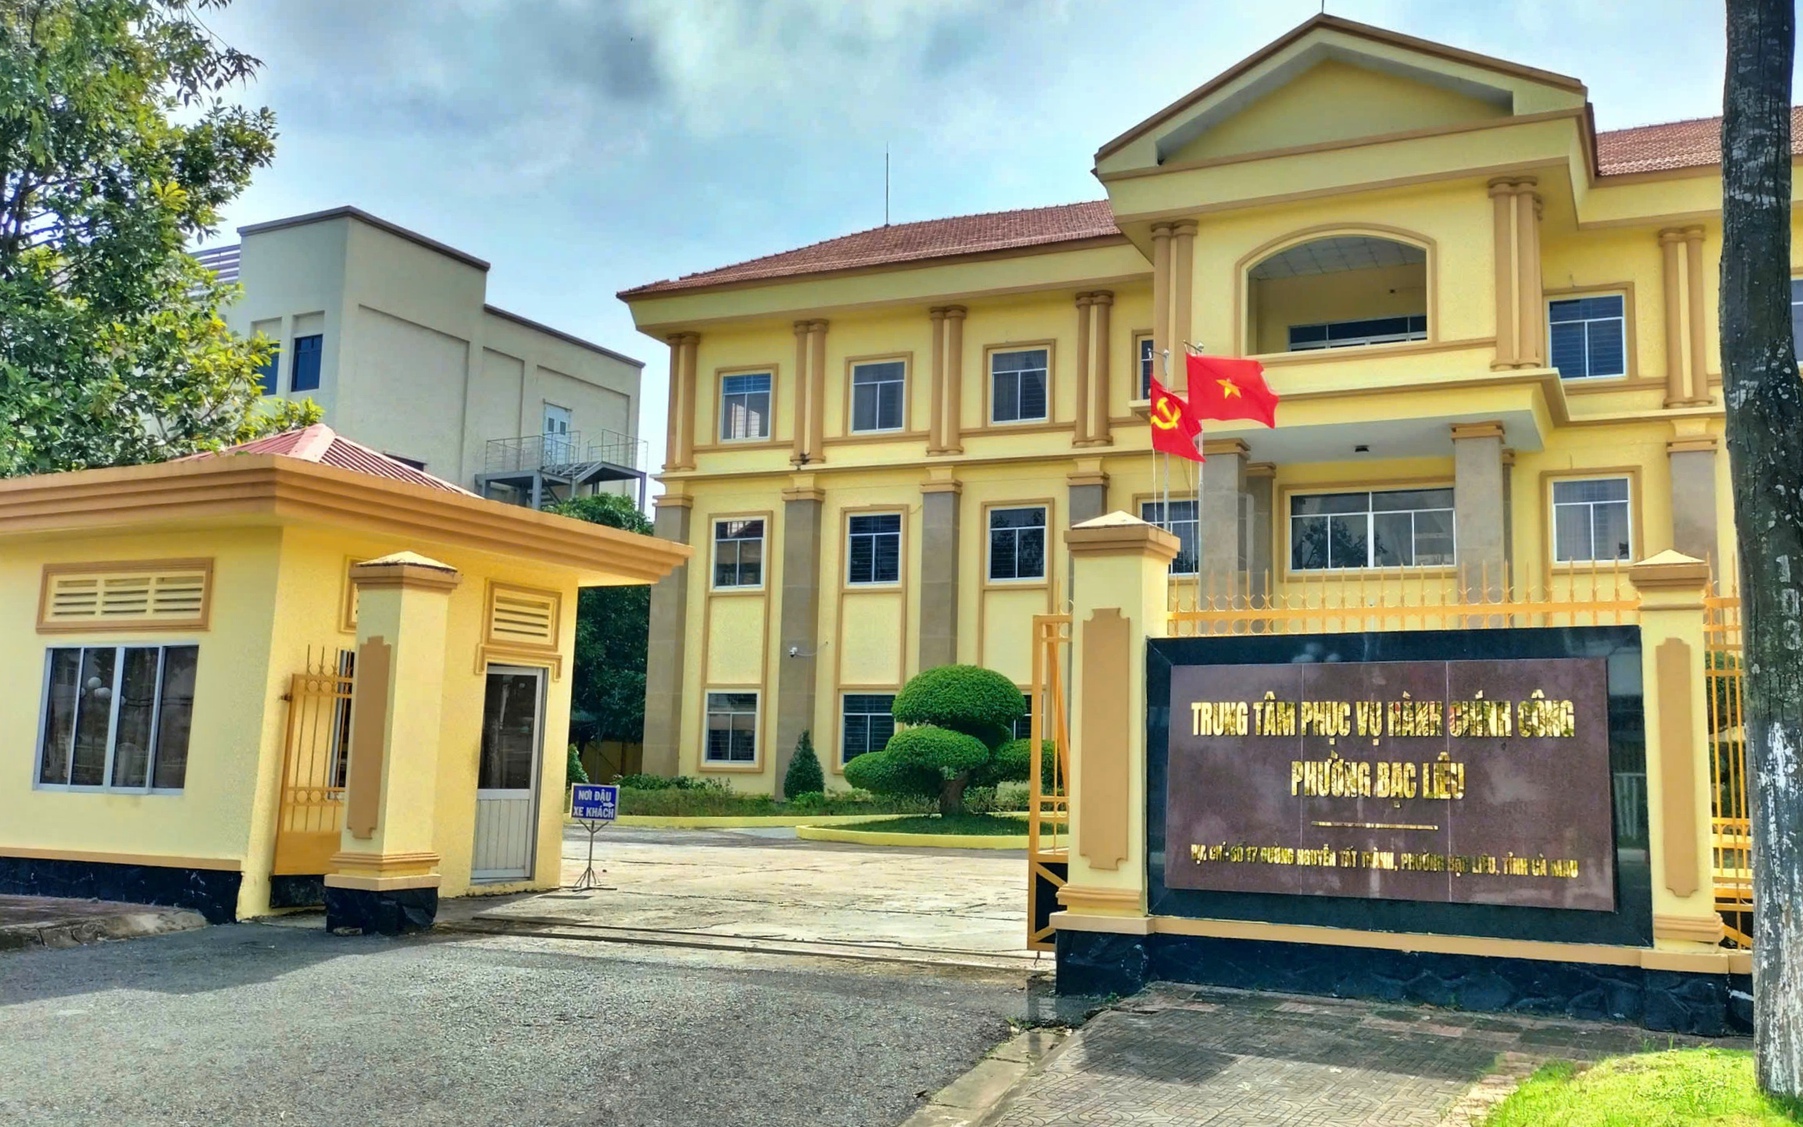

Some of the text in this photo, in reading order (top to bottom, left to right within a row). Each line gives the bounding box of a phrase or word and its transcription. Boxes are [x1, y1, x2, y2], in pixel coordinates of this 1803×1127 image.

[1191, 689, 1574, 746] TRUNG TÂM PHỤC VỤ HÀNH CHÍNH CÔNG
[578, 789, 592, 800] NƠI
[1291, 750, 1465, 808] PHƯỜNG BẠC LIÊU
[573, 805, 614, 818] XE KHÁCH
[1246, 846, 1258, 862] 17
[1261, 841, 1294, 865] ĐƯỜNG
[1297, 843, 1336, 866] NGUYỄN
[1340, 845, 1357, 867] TẤT
[1401, 848, 1444, 871] PHƯỜNG
[1448, 854, 1468, 877] BẠC
[1502, 851, 1528, 875] TỈNH
[1531, 853, 1547, 876] CÀ
[1551, 860, 1579, 878] MAU
